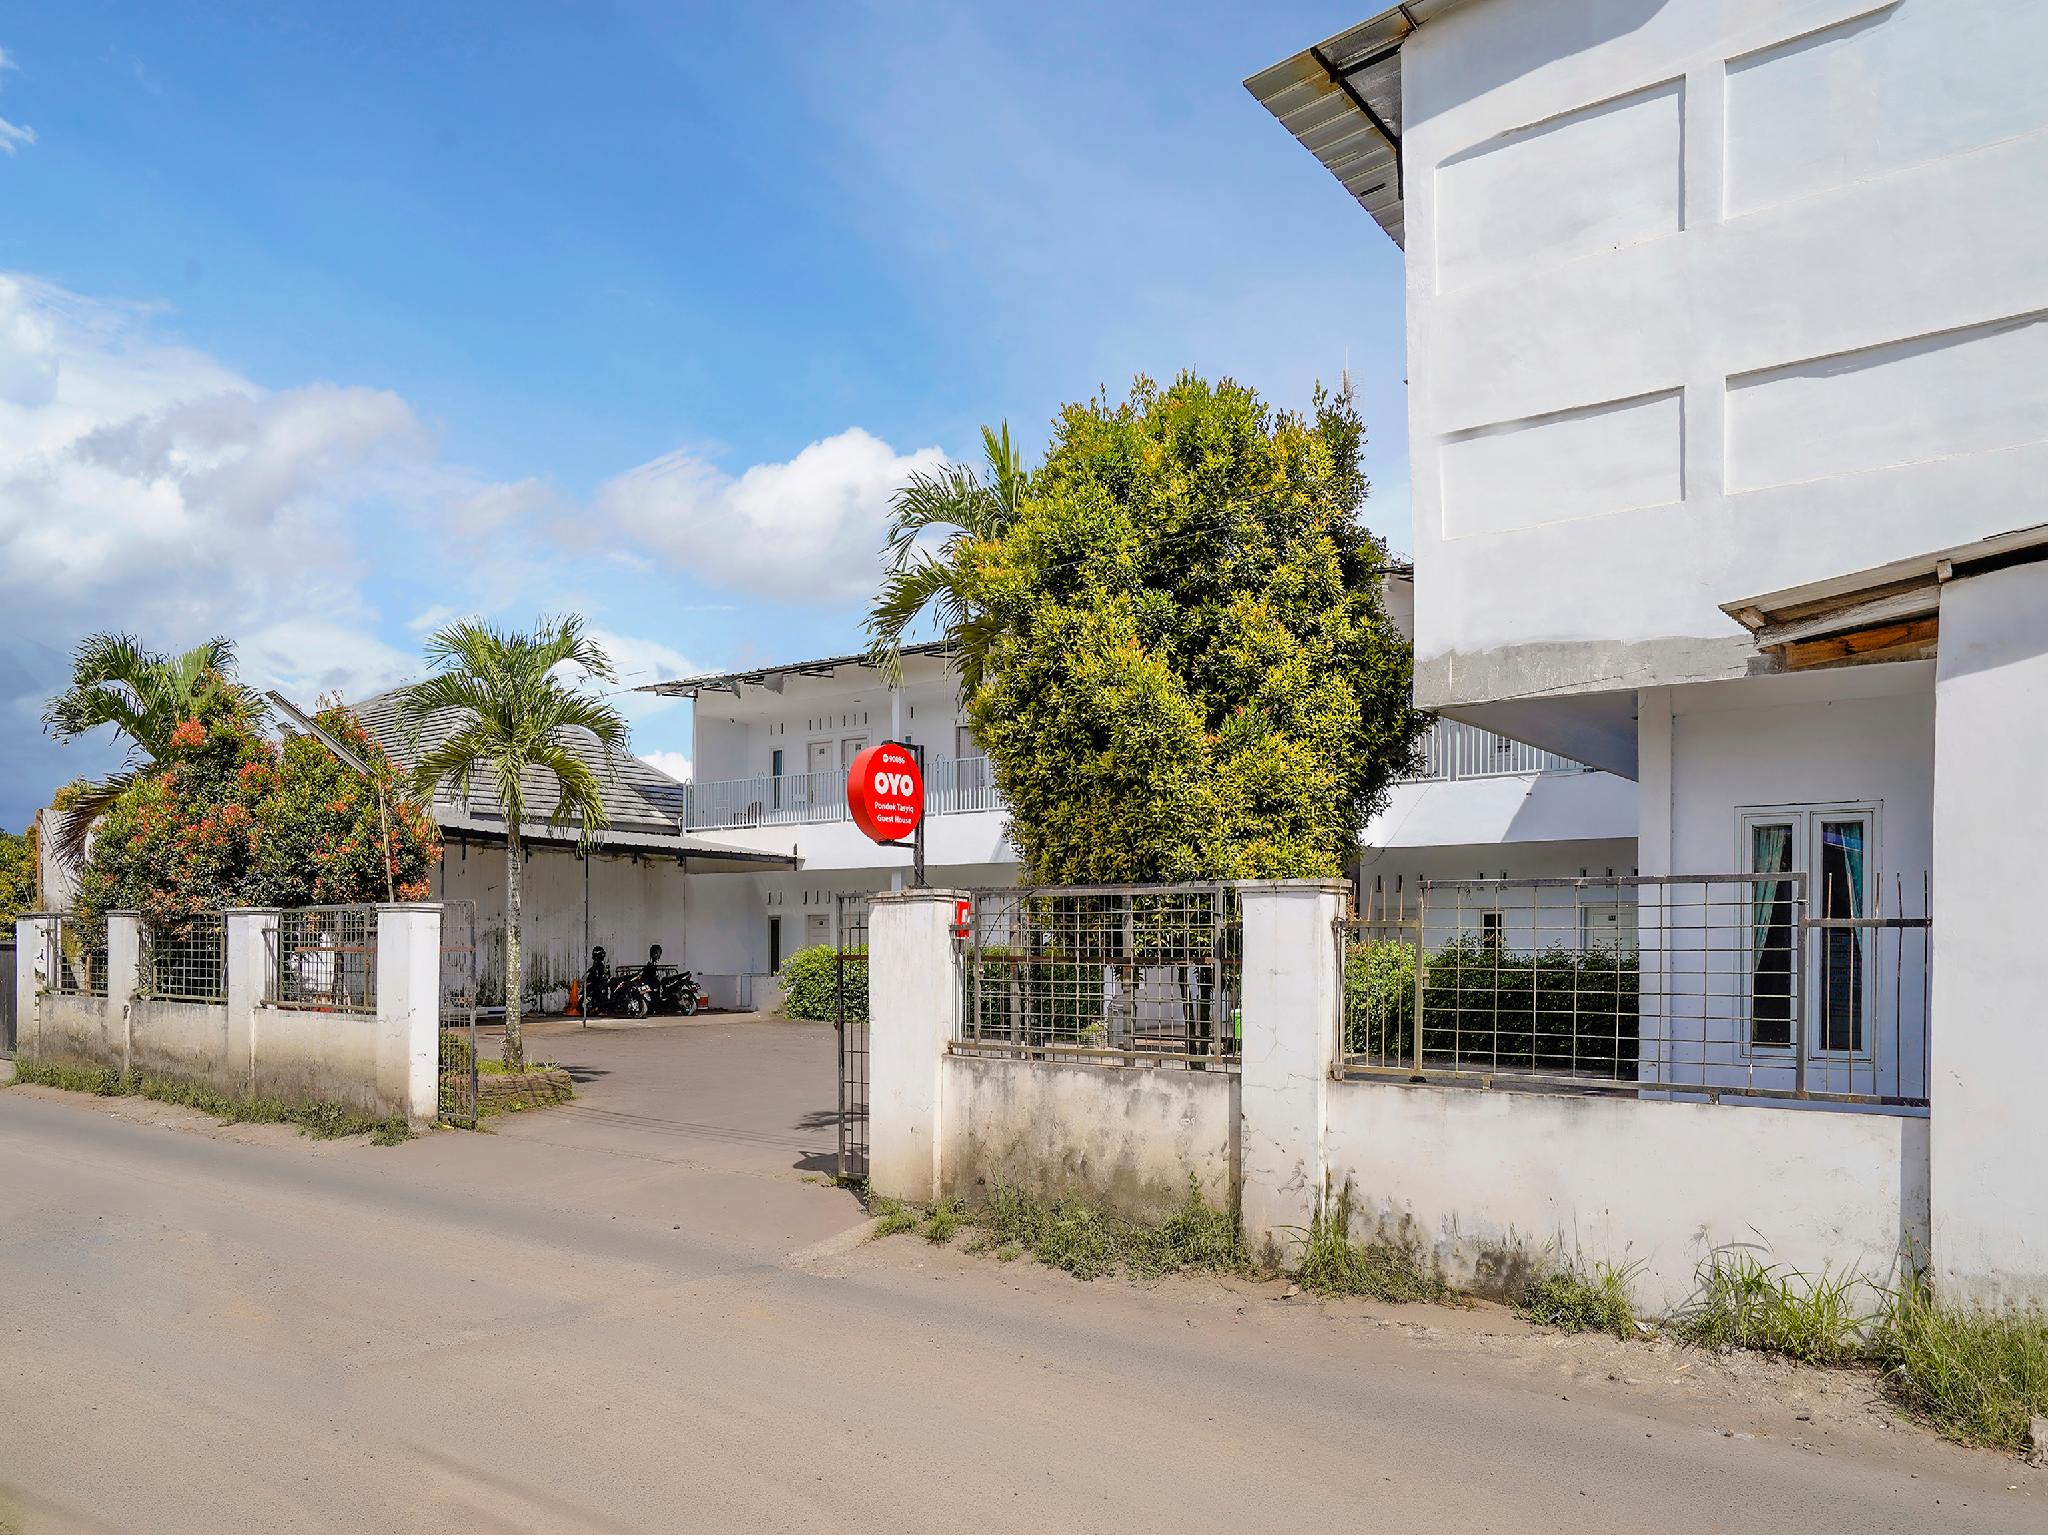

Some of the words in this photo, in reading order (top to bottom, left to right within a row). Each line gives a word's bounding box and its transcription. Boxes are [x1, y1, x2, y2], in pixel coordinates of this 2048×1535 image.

[874, 772, 913, 796] OYO
[875, 801, 896, 811] Pondok
[877, 814, 894, 823] Guest
[895, 815, 911, 824] House
